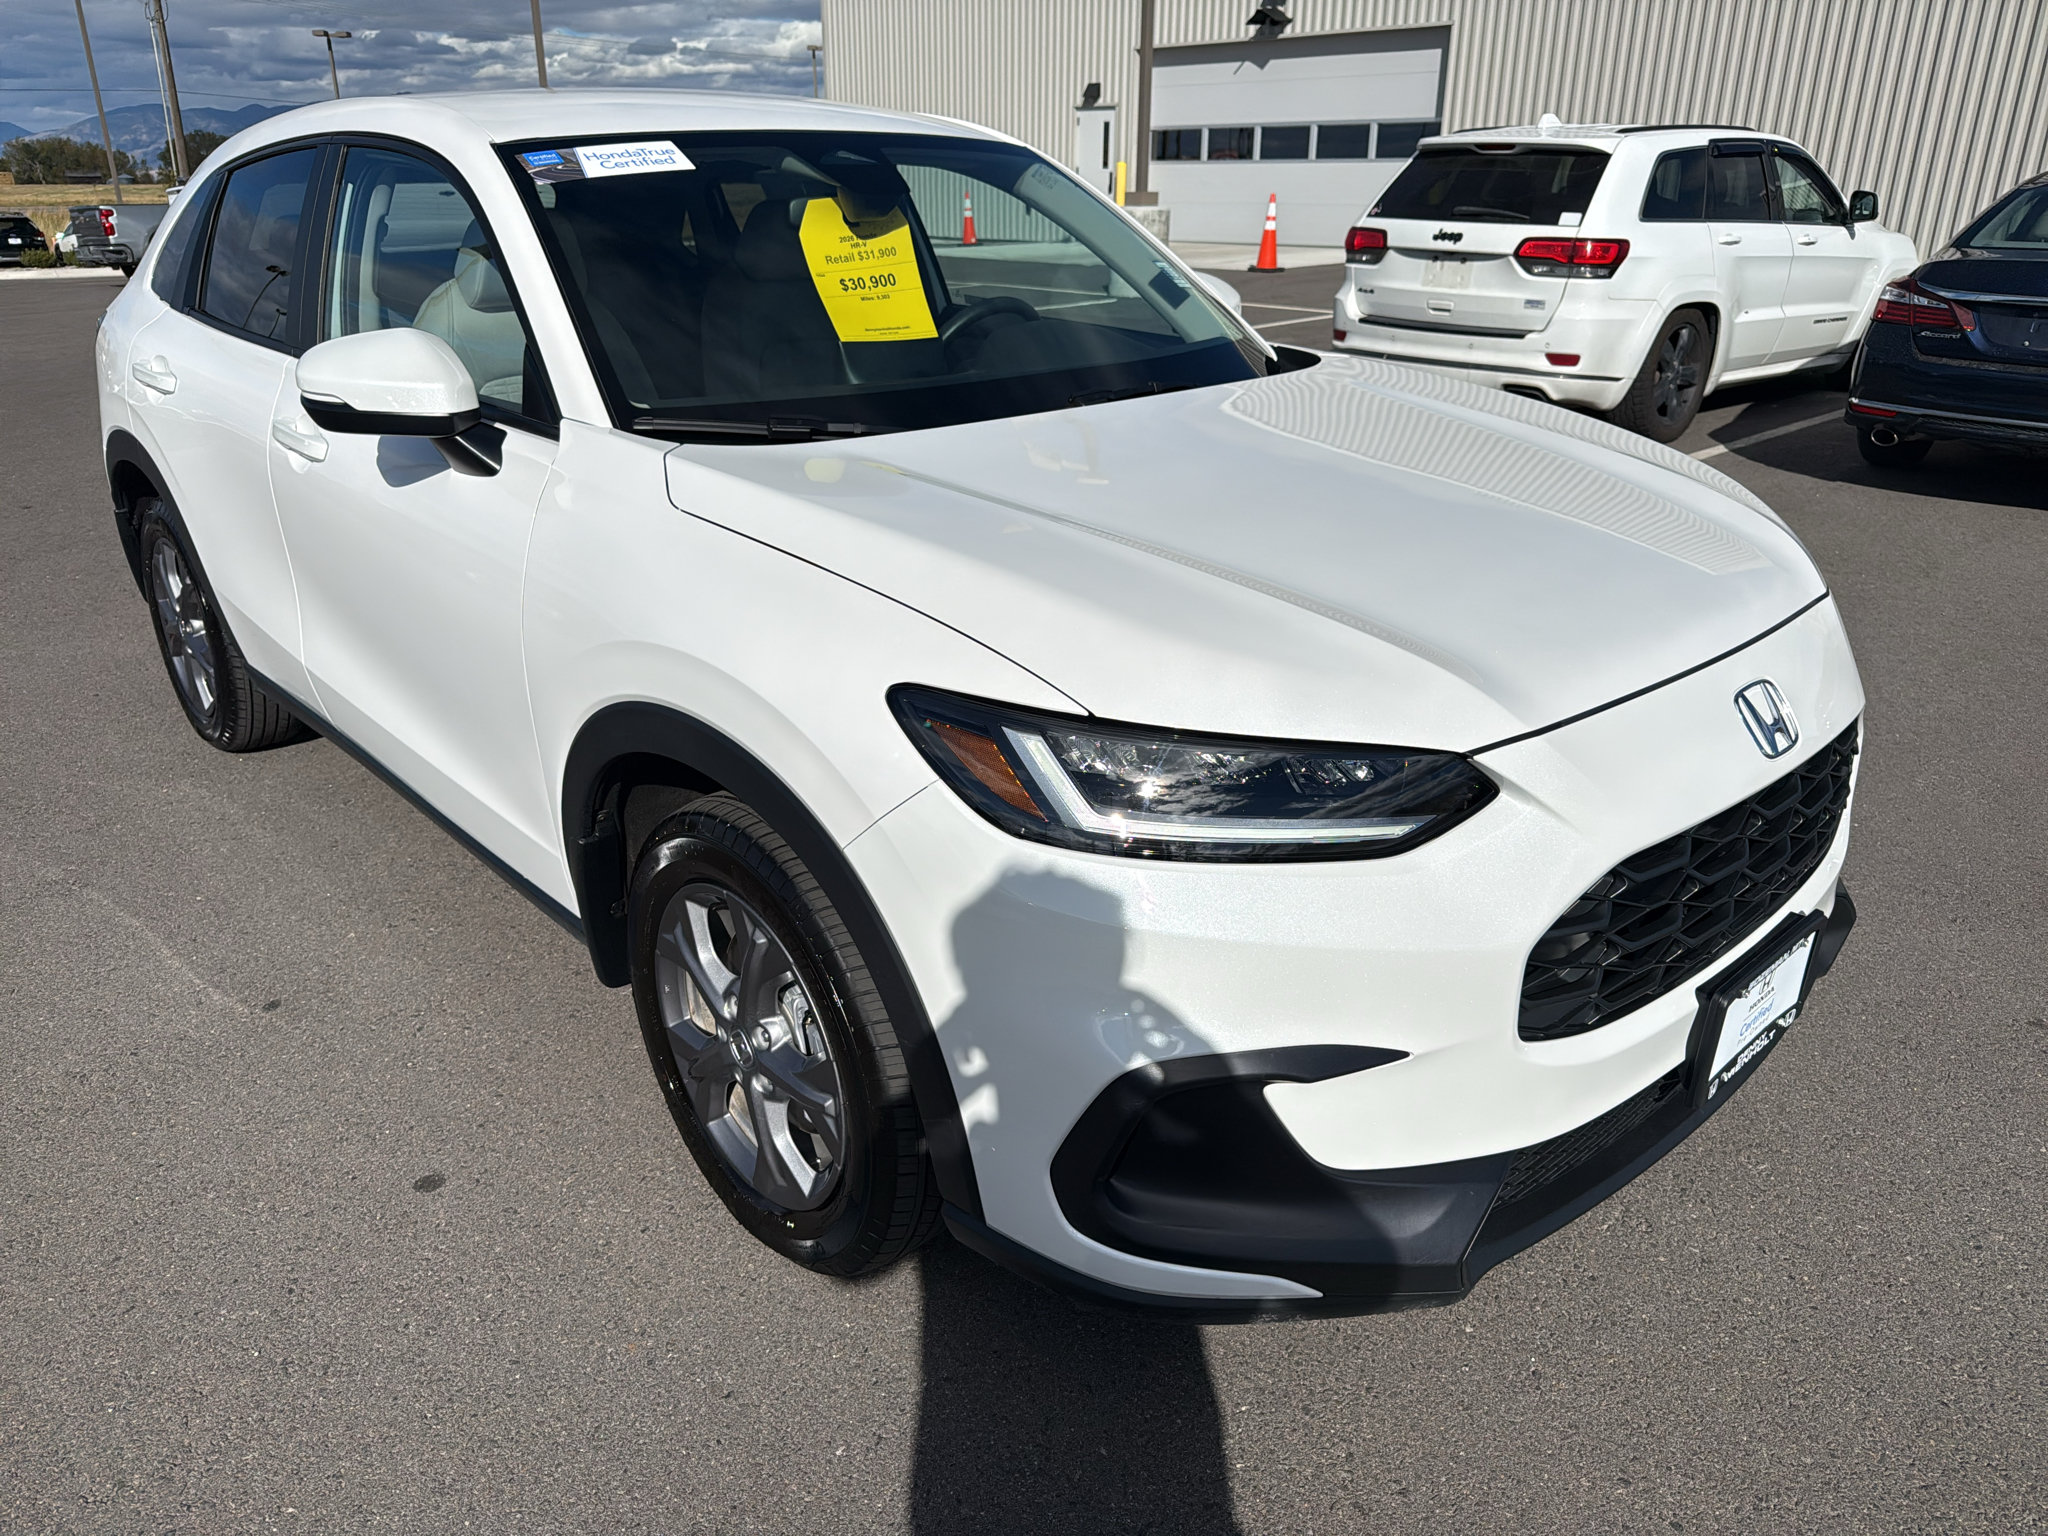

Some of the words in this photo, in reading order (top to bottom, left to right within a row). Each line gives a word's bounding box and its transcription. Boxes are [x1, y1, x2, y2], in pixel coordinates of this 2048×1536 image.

[583, 147, 676, 162] HondaTrue
[600, 156, 676, 170] Certified
[1432, 228, 1464, 245] Jeep
[825, 252, 856, 265] Retail
[857, 246, 897, 262] $31,900
[839, 273, 897, 293] $30,900
[1749, 985, 1775, 1012] HONDA
[1740, 998, 1775, 1037] Certified
[1727, 1029, 1776, 1079] MENHOLT
[1738, 1031, 1767, 1063] DENNY
